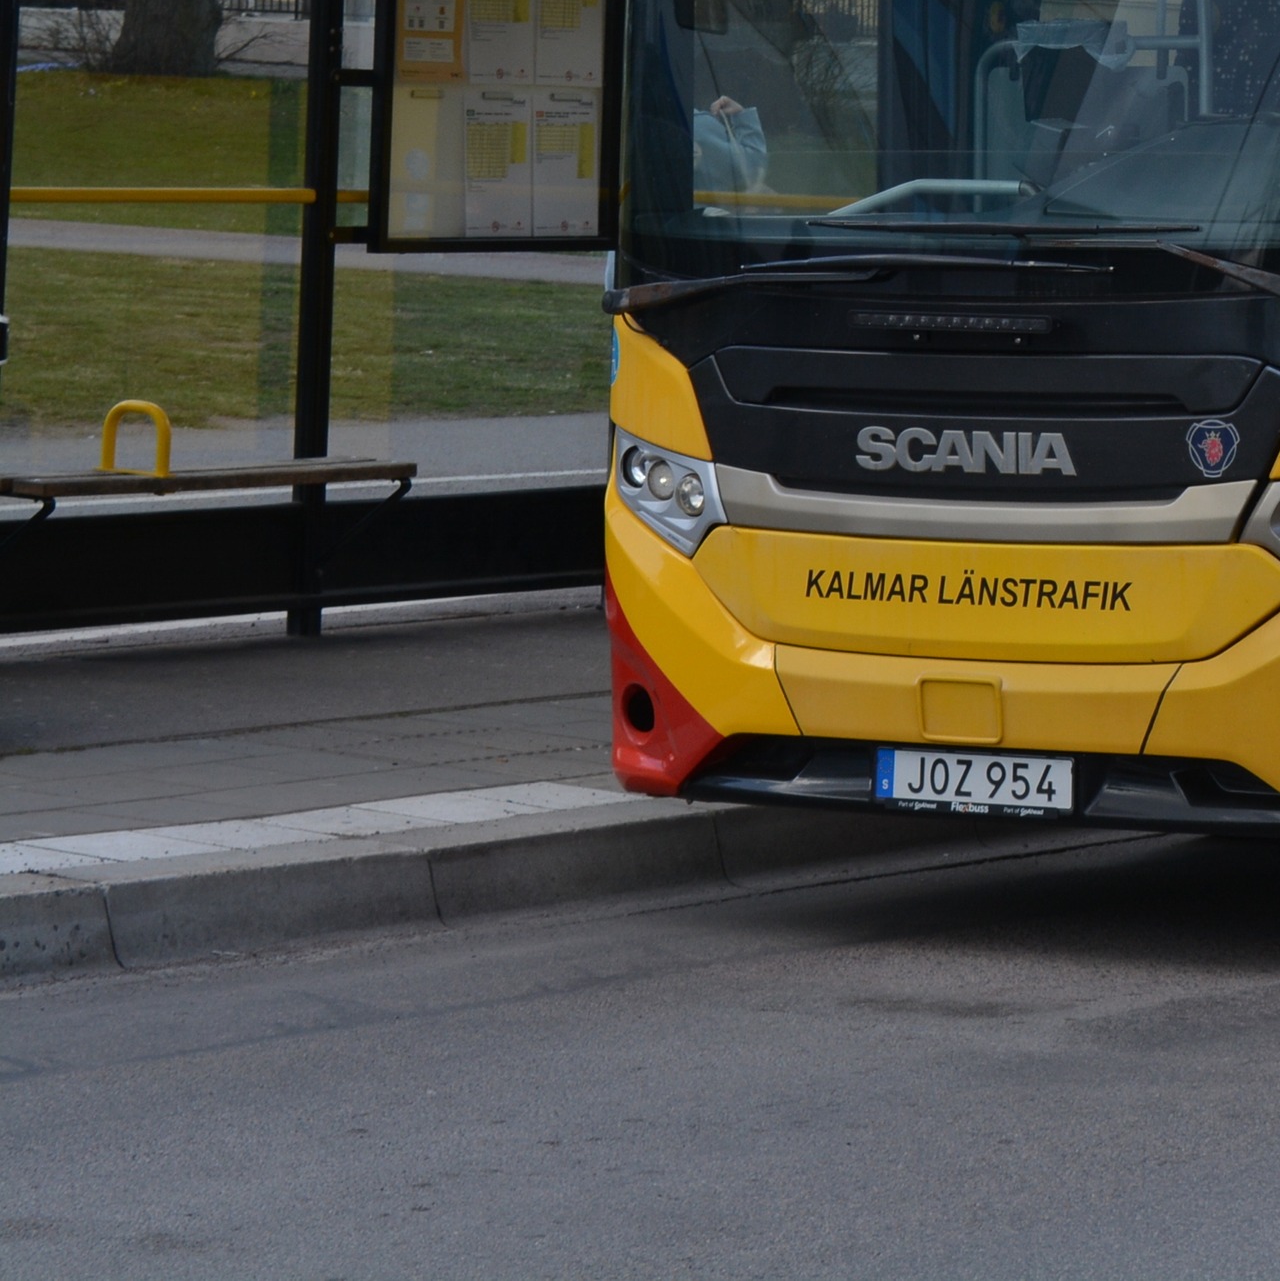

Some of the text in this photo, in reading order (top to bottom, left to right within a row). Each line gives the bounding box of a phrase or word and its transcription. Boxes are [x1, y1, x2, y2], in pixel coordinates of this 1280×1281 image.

[855, 426, 1077, 476] SCANIA
[805, 569, 1132, 611] KALMAR LÄNSTRAFIK
[882, 779, 889, 790] S
[907, 757, 1056, 802] JOZ 954
[950, 801, 989, 813] Flexbuss
